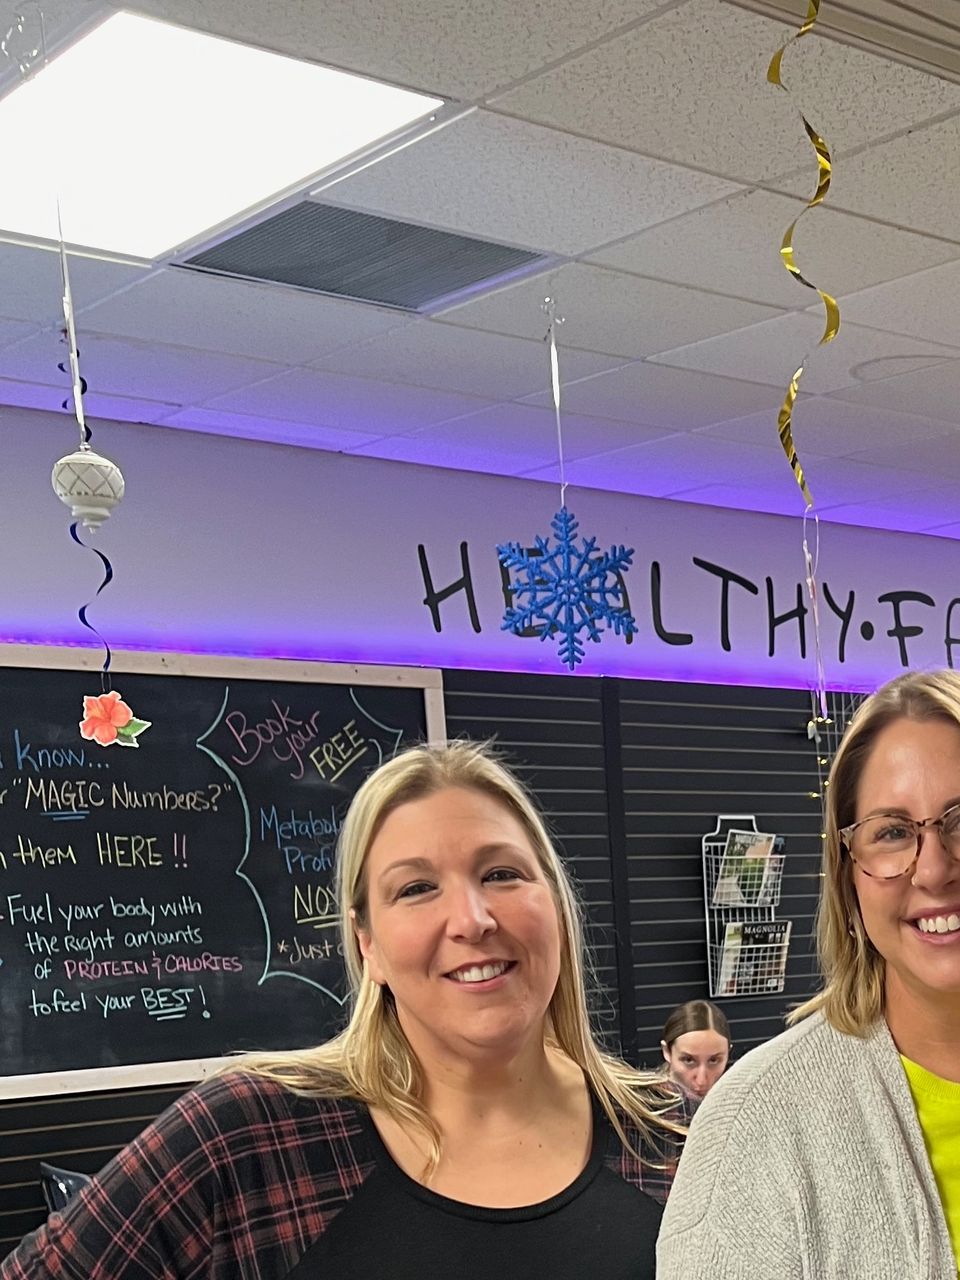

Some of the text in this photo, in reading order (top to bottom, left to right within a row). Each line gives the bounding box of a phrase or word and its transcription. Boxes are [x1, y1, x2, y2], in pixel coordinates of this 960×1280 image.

[226, 699, 303, 766] Book
[272, 711, 320, 780] your
[309, 719, 366, 779] FREE
[260, 804, 344, 849] Metabol
[283, 846, 332, 875] Profi
[7, 893, 202, 931] Fuel your body with
[25, 930, 60, 954] the
[124, 926, 203, 949] amounts
[743, 925, 786, 935] MAGNOLIA
[34, 960, 52, 981] of
[64, 960, 149, 980] PROTEIN
[164, 953, 244, 973] CALORIES
[99, 994, 137, 1018] your
